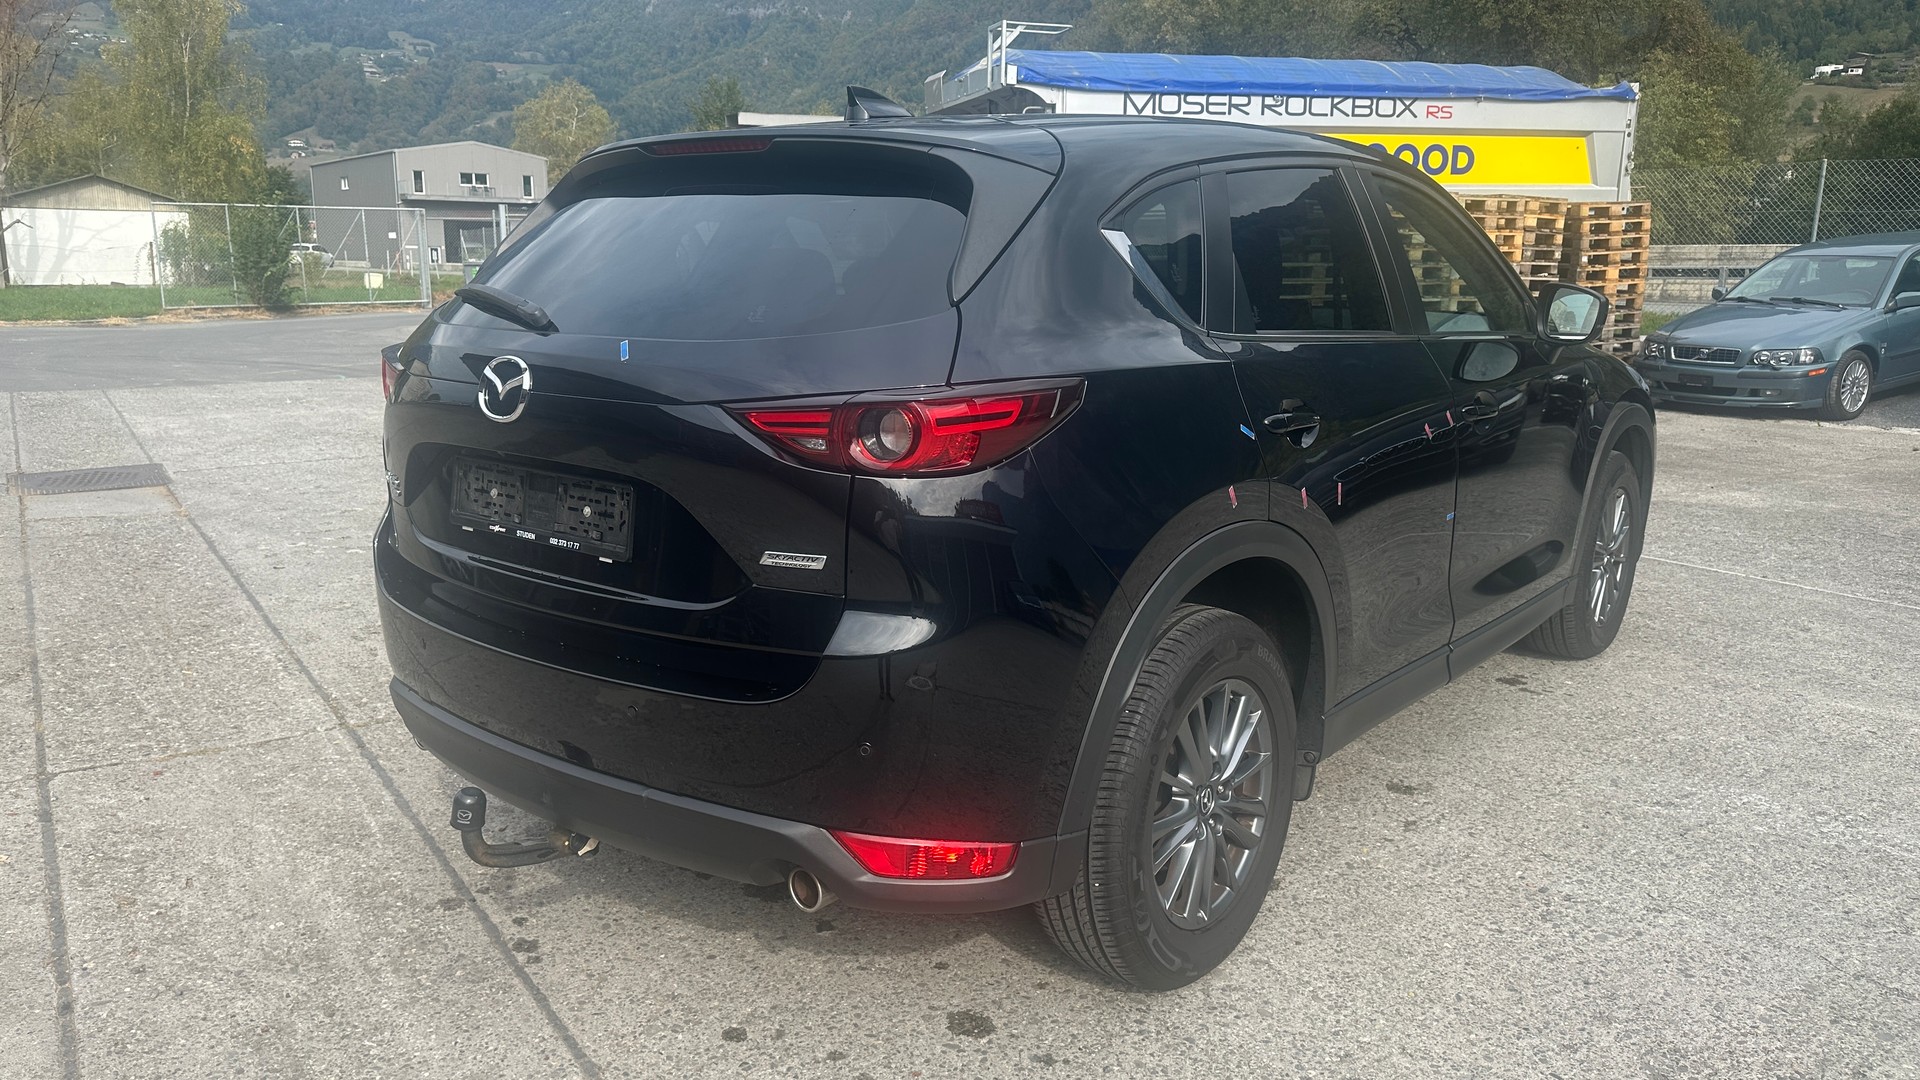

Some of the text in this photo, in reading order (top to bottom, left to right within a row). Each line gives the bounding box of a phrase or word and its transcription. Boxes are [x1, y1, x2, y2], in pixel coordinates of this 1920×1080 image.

[1123, 92, 1454, 119] MOSER ROCKBOX RS
[1368, 143, 1475, 175] OOD
[766, 554, 819, 562] SKYACTIV
